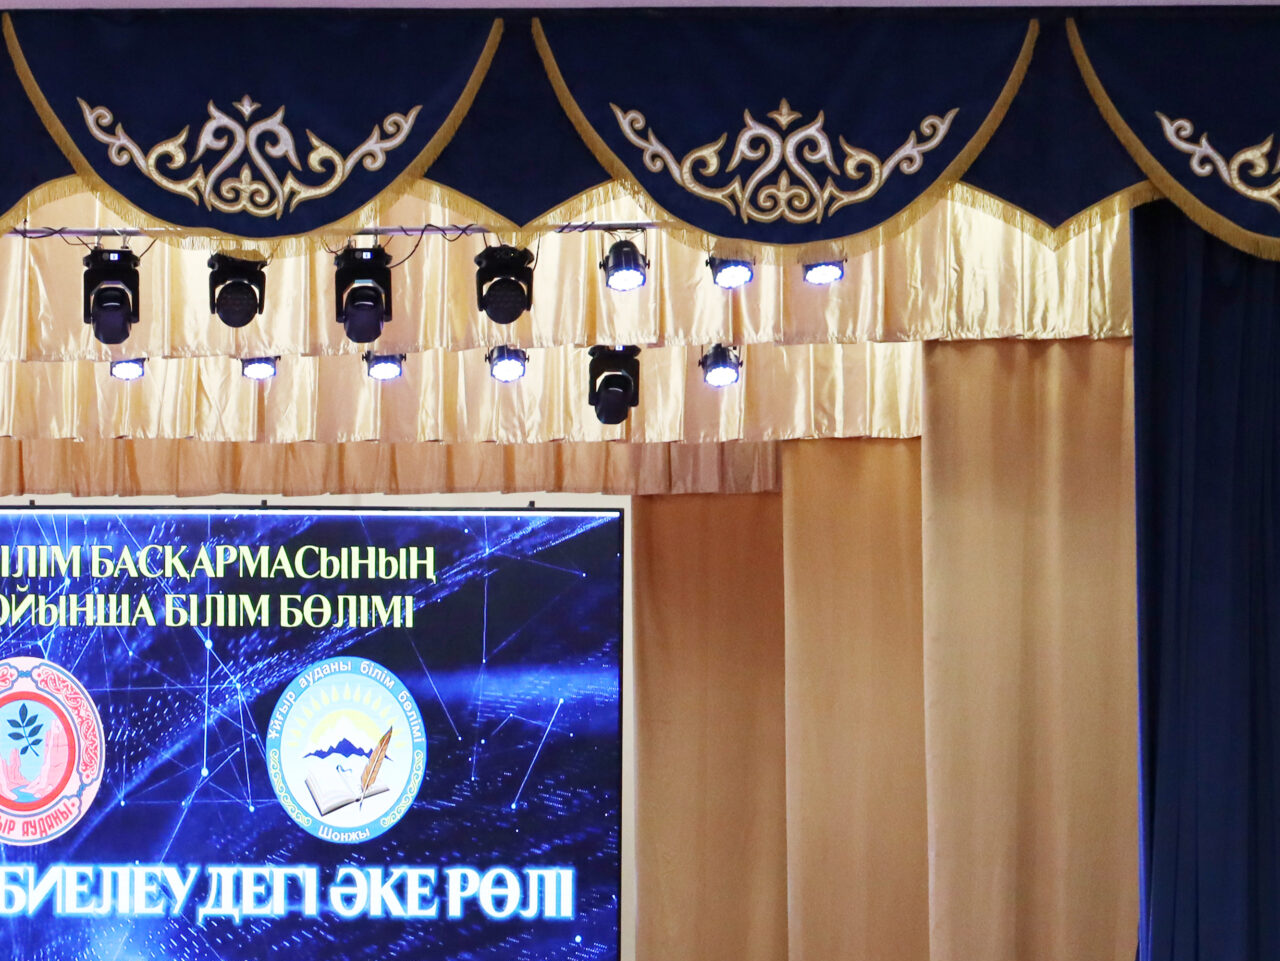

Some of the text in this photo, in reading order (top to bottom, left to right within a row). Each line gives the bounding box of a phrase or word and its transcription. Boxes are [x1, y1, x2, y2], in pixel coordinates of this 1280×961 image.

[90, 544, 437, 584] БАСҚАРМАСЫНЫҢ
[164, 594, 270, 628] БІЛІМ
[279, 594, 415, 628] БӨЛІМІ
[267, 660, 424, 742] Ұйғыр ауданы білім бөлімі
[22, 803, 72, 837] АУДАНЫ
[318, 825, 370, 842] Шонжы
[330, 866, 438, 918] ӘКЕ
[446, 867, 576, 919] РӨЛІ
